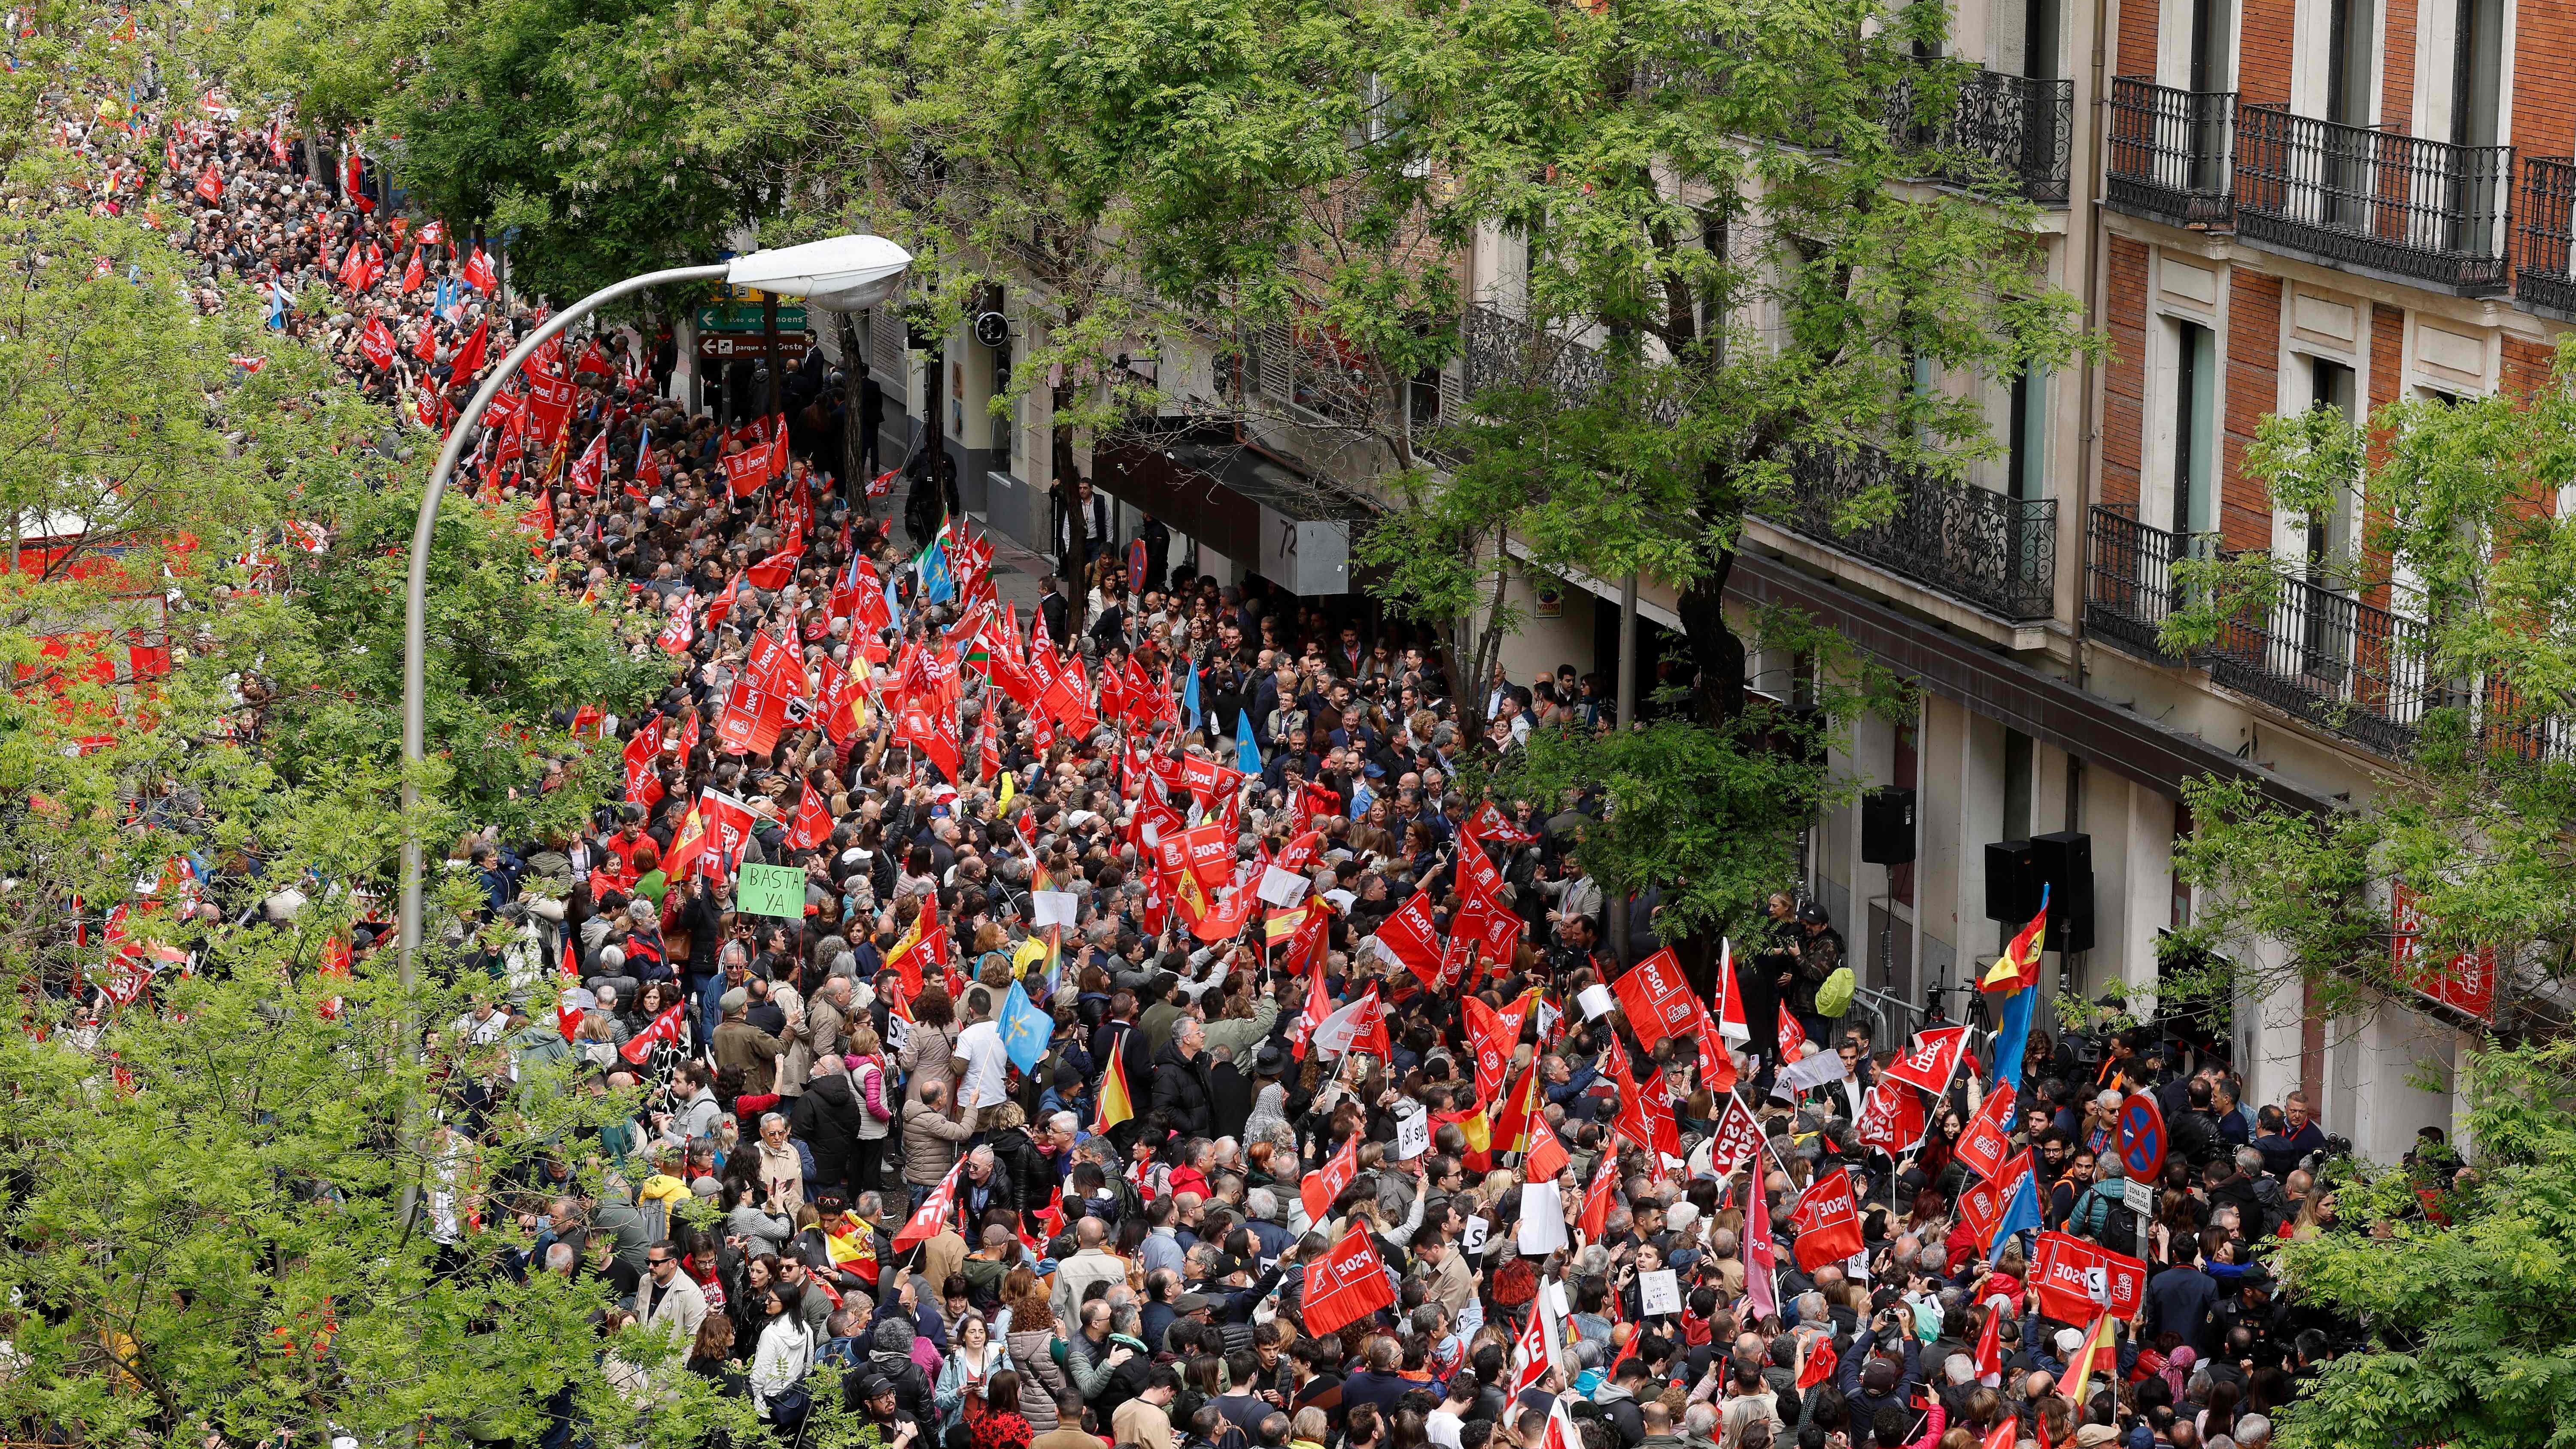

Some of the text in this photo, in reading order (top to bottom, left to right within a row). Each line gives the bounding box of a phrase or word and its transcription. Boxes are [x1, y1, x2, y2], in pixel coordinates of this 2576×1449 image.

[760, 315, 802, 323] Cmoens
[736, 345, 763, 353] parque
[1280, 519, 1297, 559] 72
[1032, 659, 1052, 685] PSOE
[750, 867, 800, 890] BASTA
[766, 893, 794, 917] YA!!
[1468, 900, 1482, 909] PS
[1406, 906, 1432, 936] PSOE
[920, 942, 936, 964] PSO
[1643, 963, 1668, 998] PSOE
[2126, 1194, 2149, 1209] SEGURIDAD
[2129, 1186, 2147, 1200] ZONA DE
